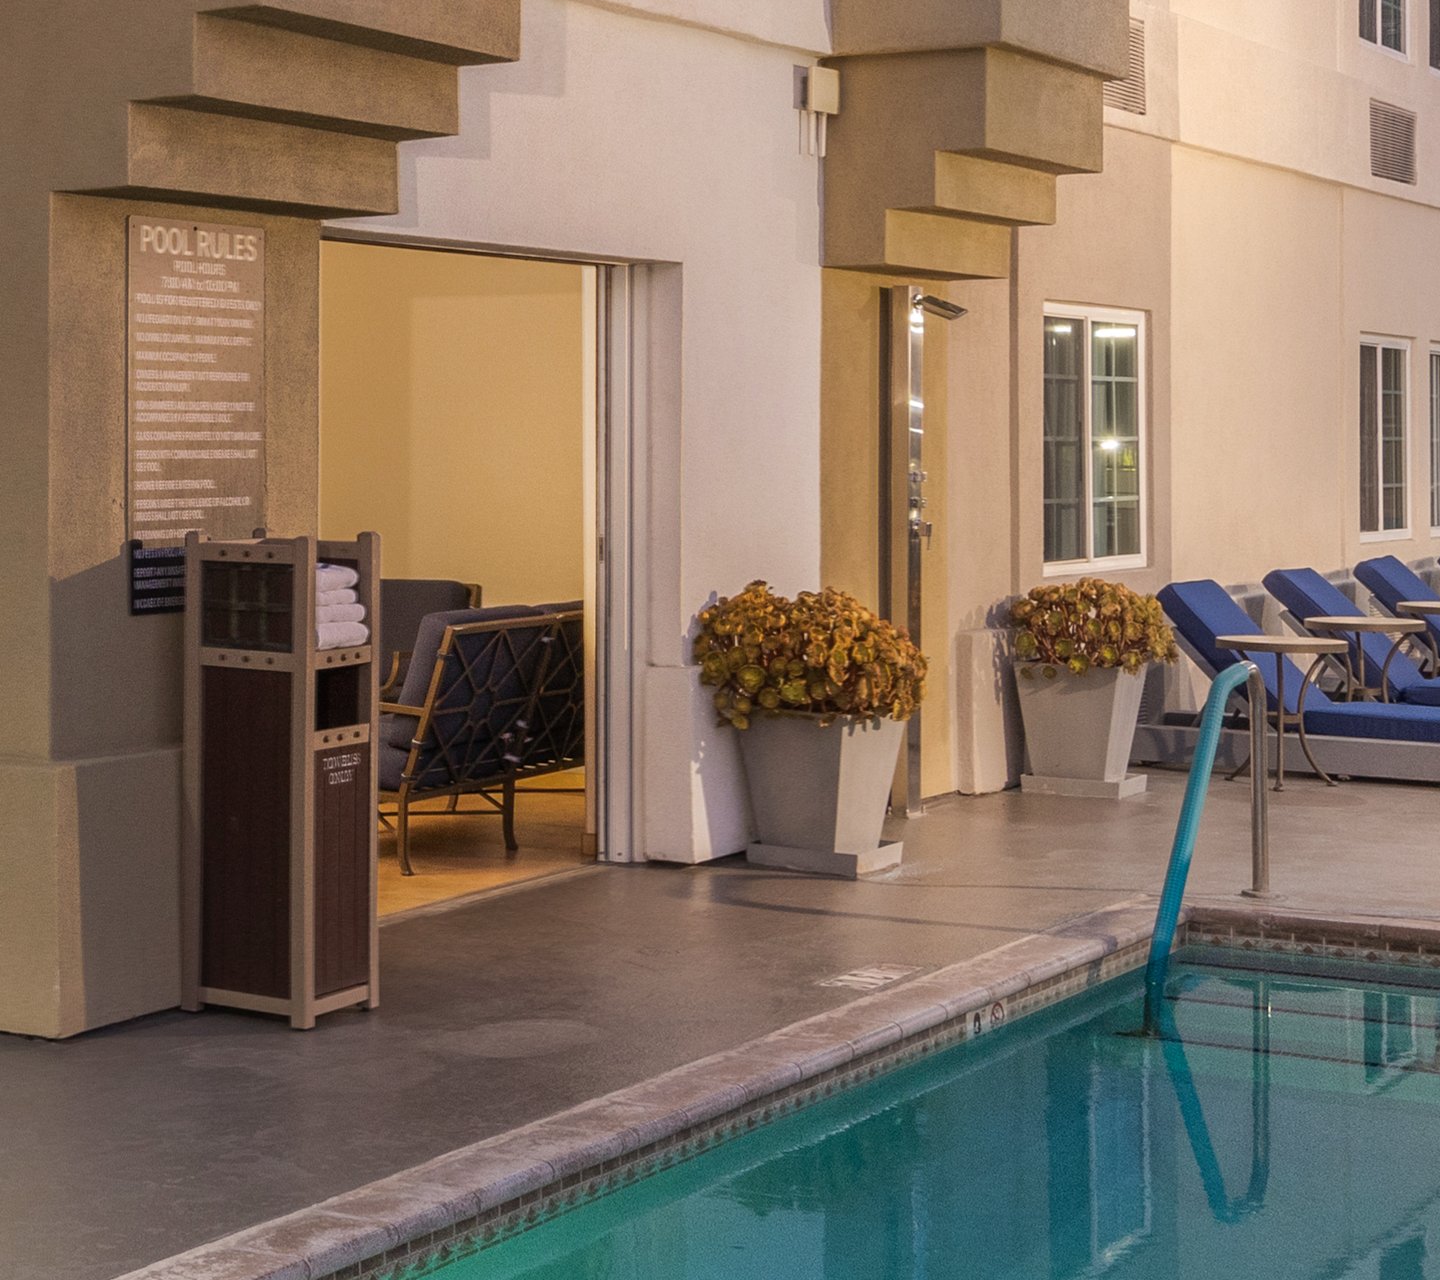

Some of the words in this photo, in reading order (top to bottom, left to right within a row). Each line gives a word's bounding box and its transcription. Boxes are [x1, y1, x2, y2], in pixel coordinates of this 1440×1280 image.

[140, 225, 194, 256] POOL
[197, 230, 258, 261] RULES
[322, 753, 361, 770] TOWELS
[329, 769, 355, 784] ONLY
